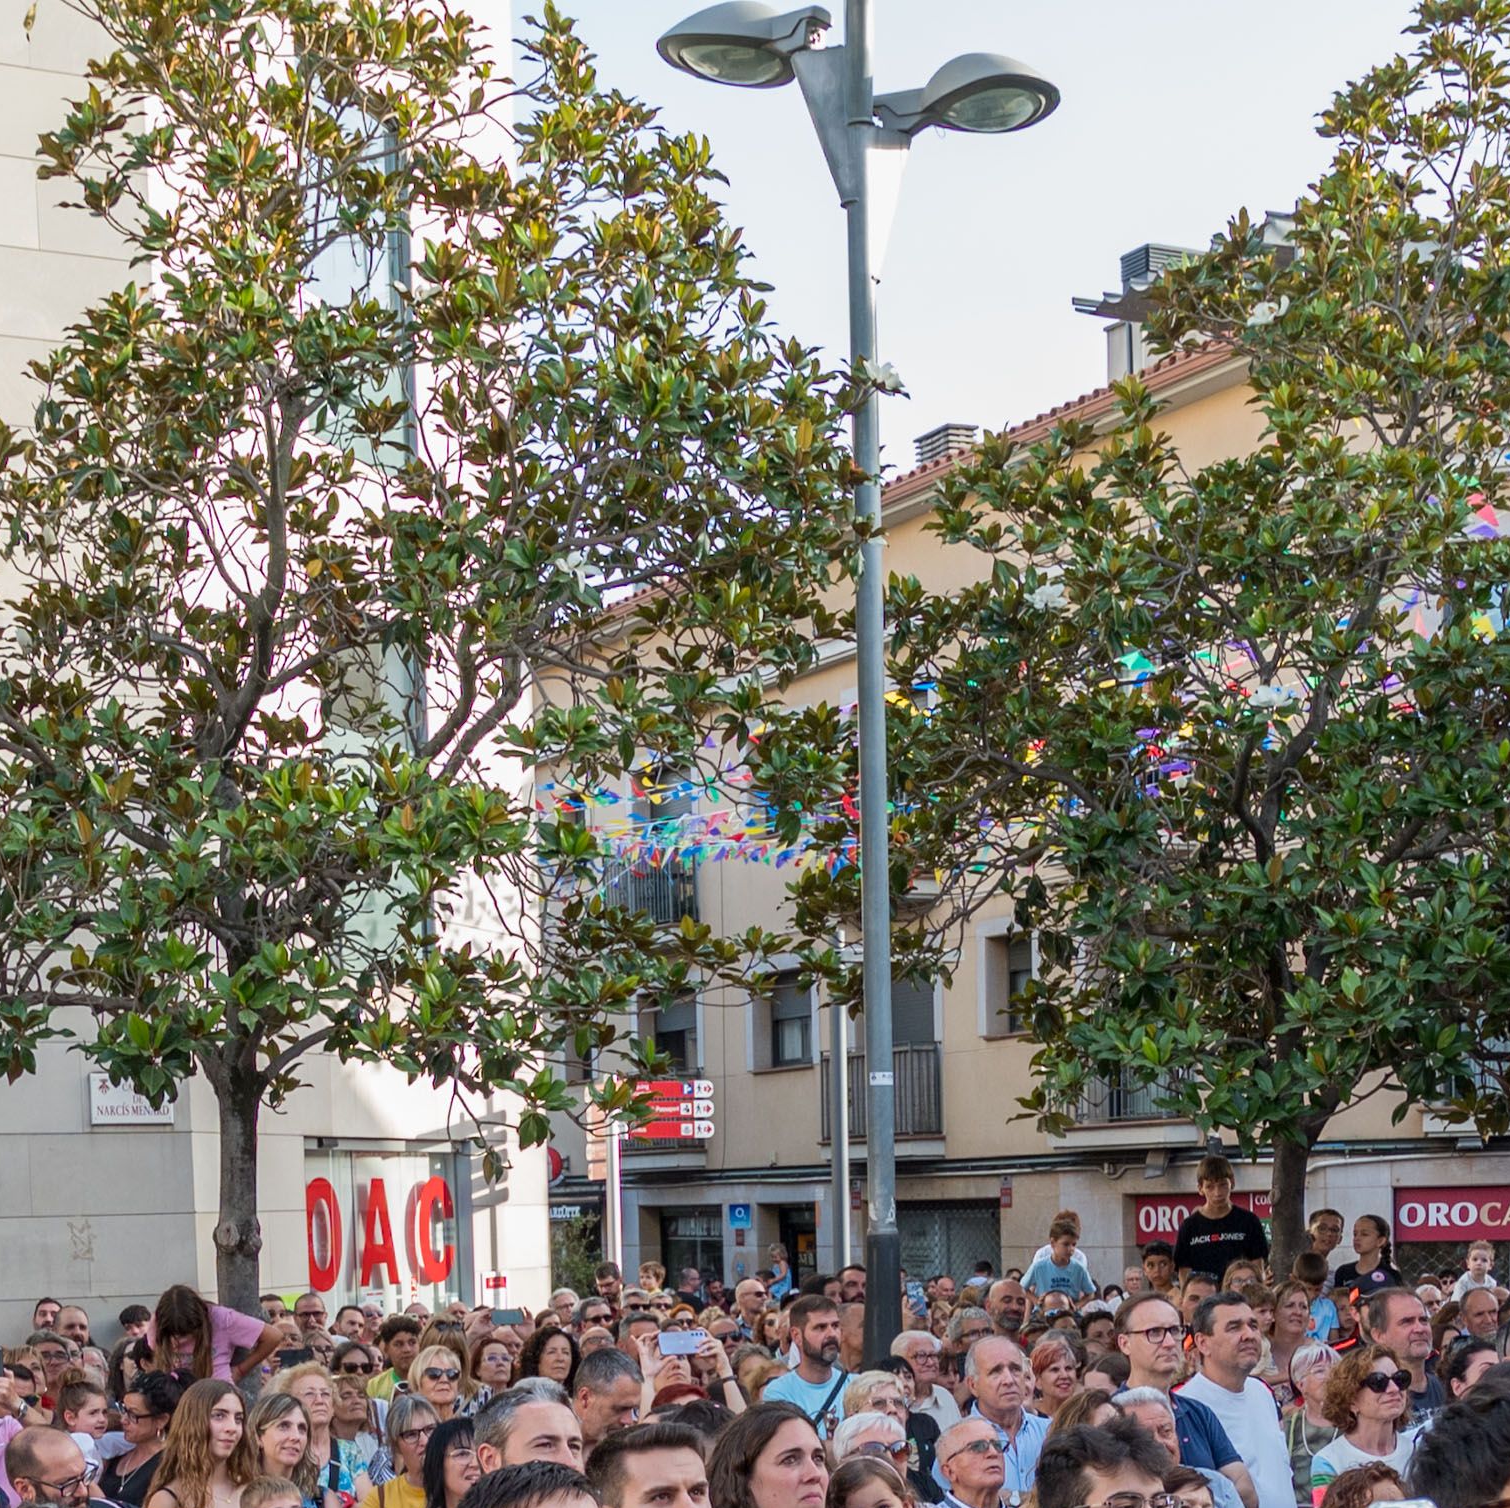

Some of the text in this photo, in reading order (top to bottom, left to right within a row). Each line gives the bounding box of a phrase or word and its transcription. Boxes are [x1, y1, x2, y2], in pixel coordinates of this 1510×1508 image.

[97, 1101, 129, 1116] NARCÍS
[306, 1175, 455, 1292] OAC
[1190, 1234, 1211, 1246] JACK
